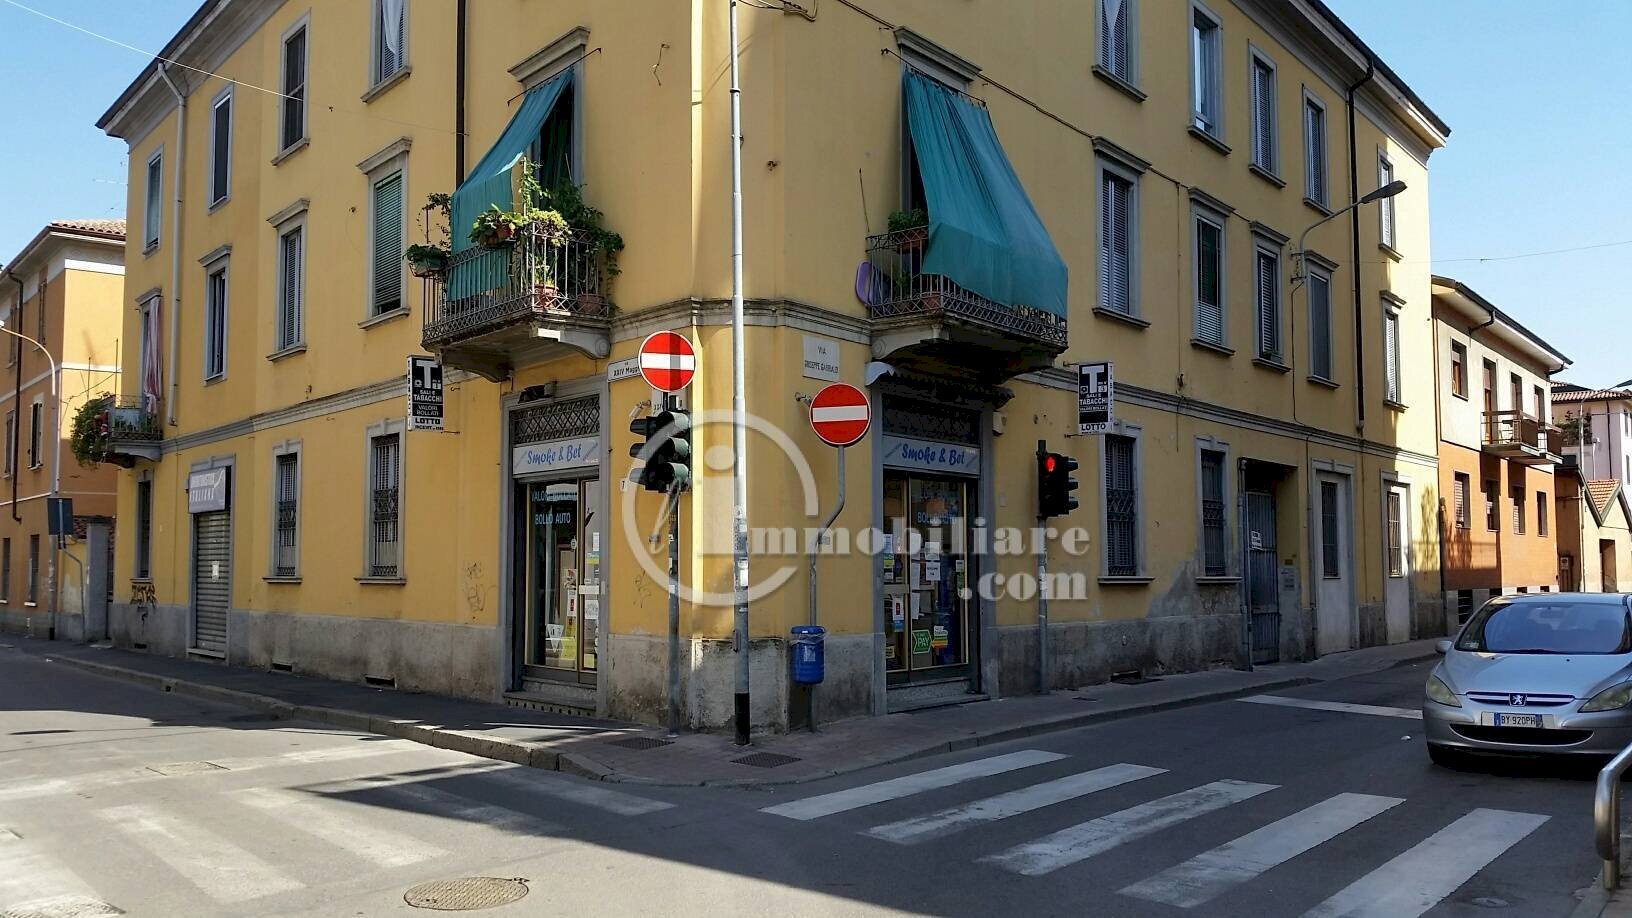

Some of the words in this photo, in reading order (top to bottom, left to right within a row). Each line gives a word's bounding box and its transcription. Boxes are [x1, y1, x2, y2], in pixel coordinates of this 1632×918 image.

[1081, 364, 1105, 394] T
[415, 417, 441, 425] LOTTO
[1081, 423, 1106, 431] LOTTO
[527, 447, 556, 465] Smoke
[558, 446, 565, 461] &
[566, 444, 582, 462] Bet
[902, 443, 936, 464] Smoke
[938, 447, 946, 463] &
[949, 449, 965, 466] Bet
[535, 513, 553, 525] BOLLO
[555, 512, 571, 524] AUTO
[1501, 715, 1510, 725] BY
